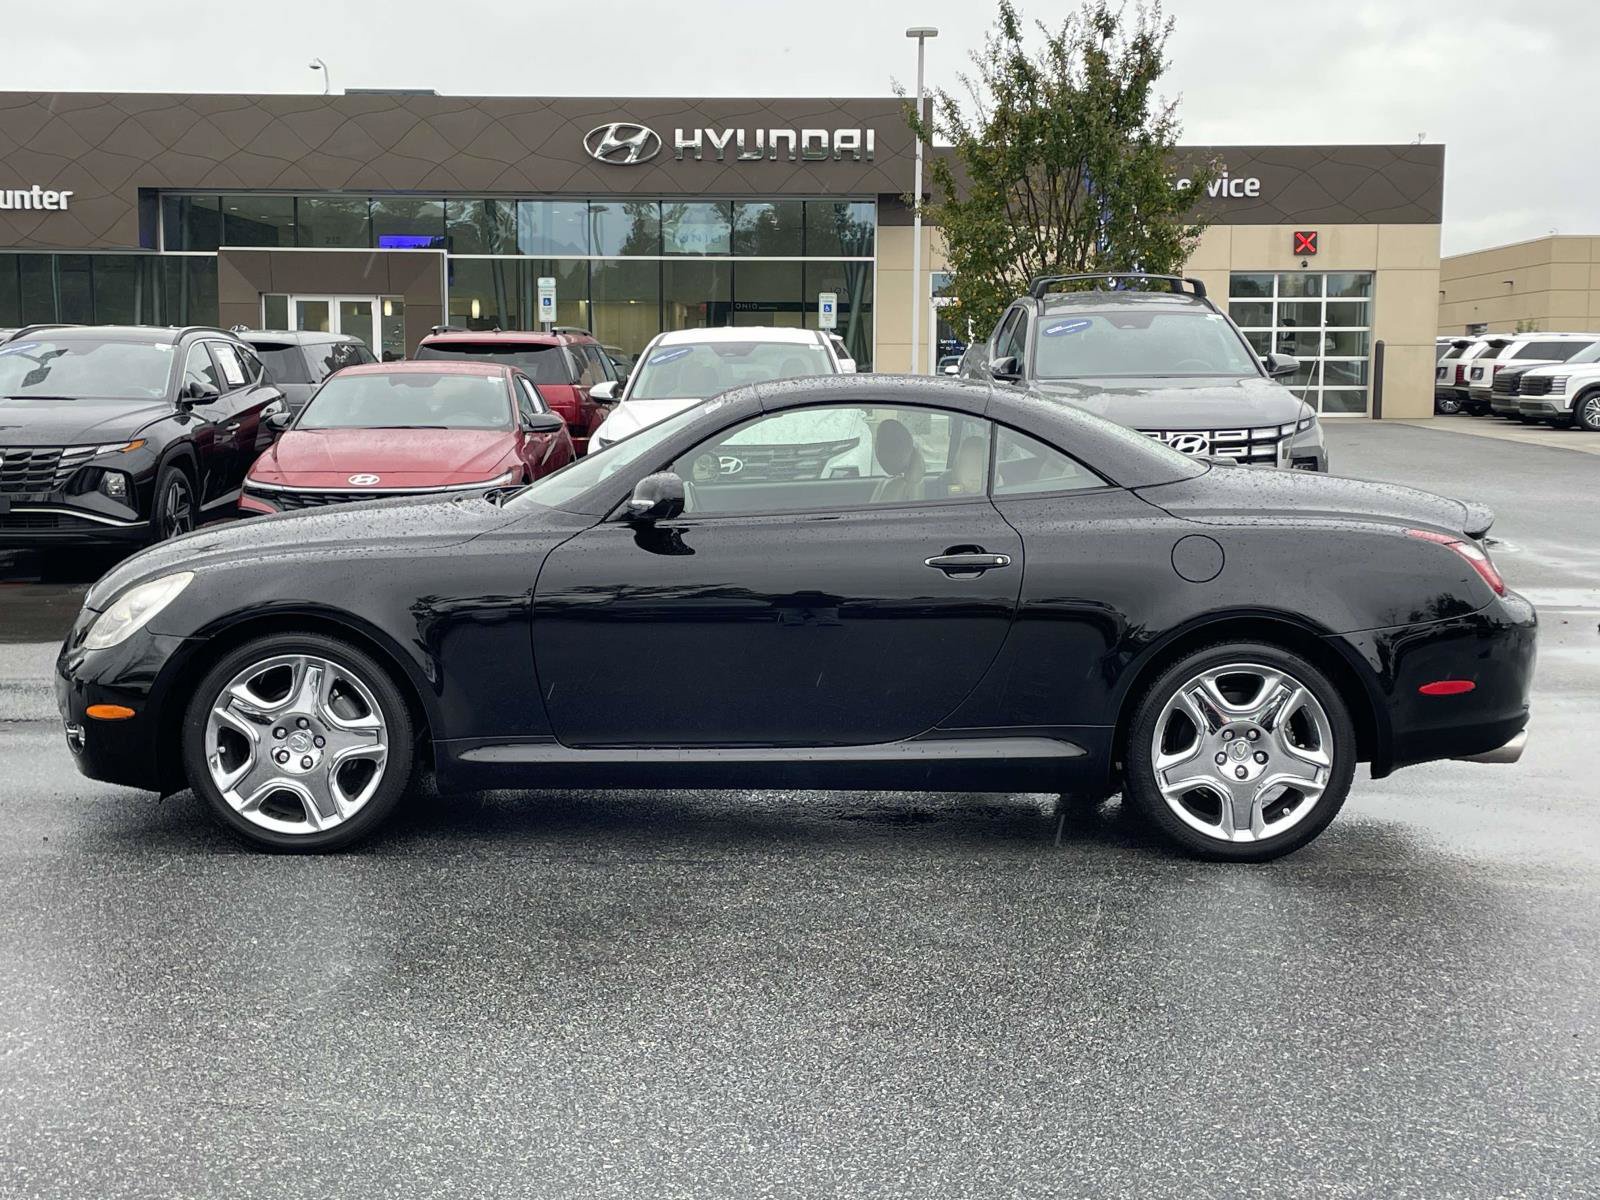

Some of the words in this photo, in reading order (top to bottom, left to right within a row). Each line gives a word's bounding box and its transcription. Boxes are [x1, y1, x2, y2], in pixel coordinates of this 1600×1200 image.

[674, 128, 875, 161] HYUNDAI
[0, 184, 74, 210] unter
[1162, 171, 1261, 198] evice
